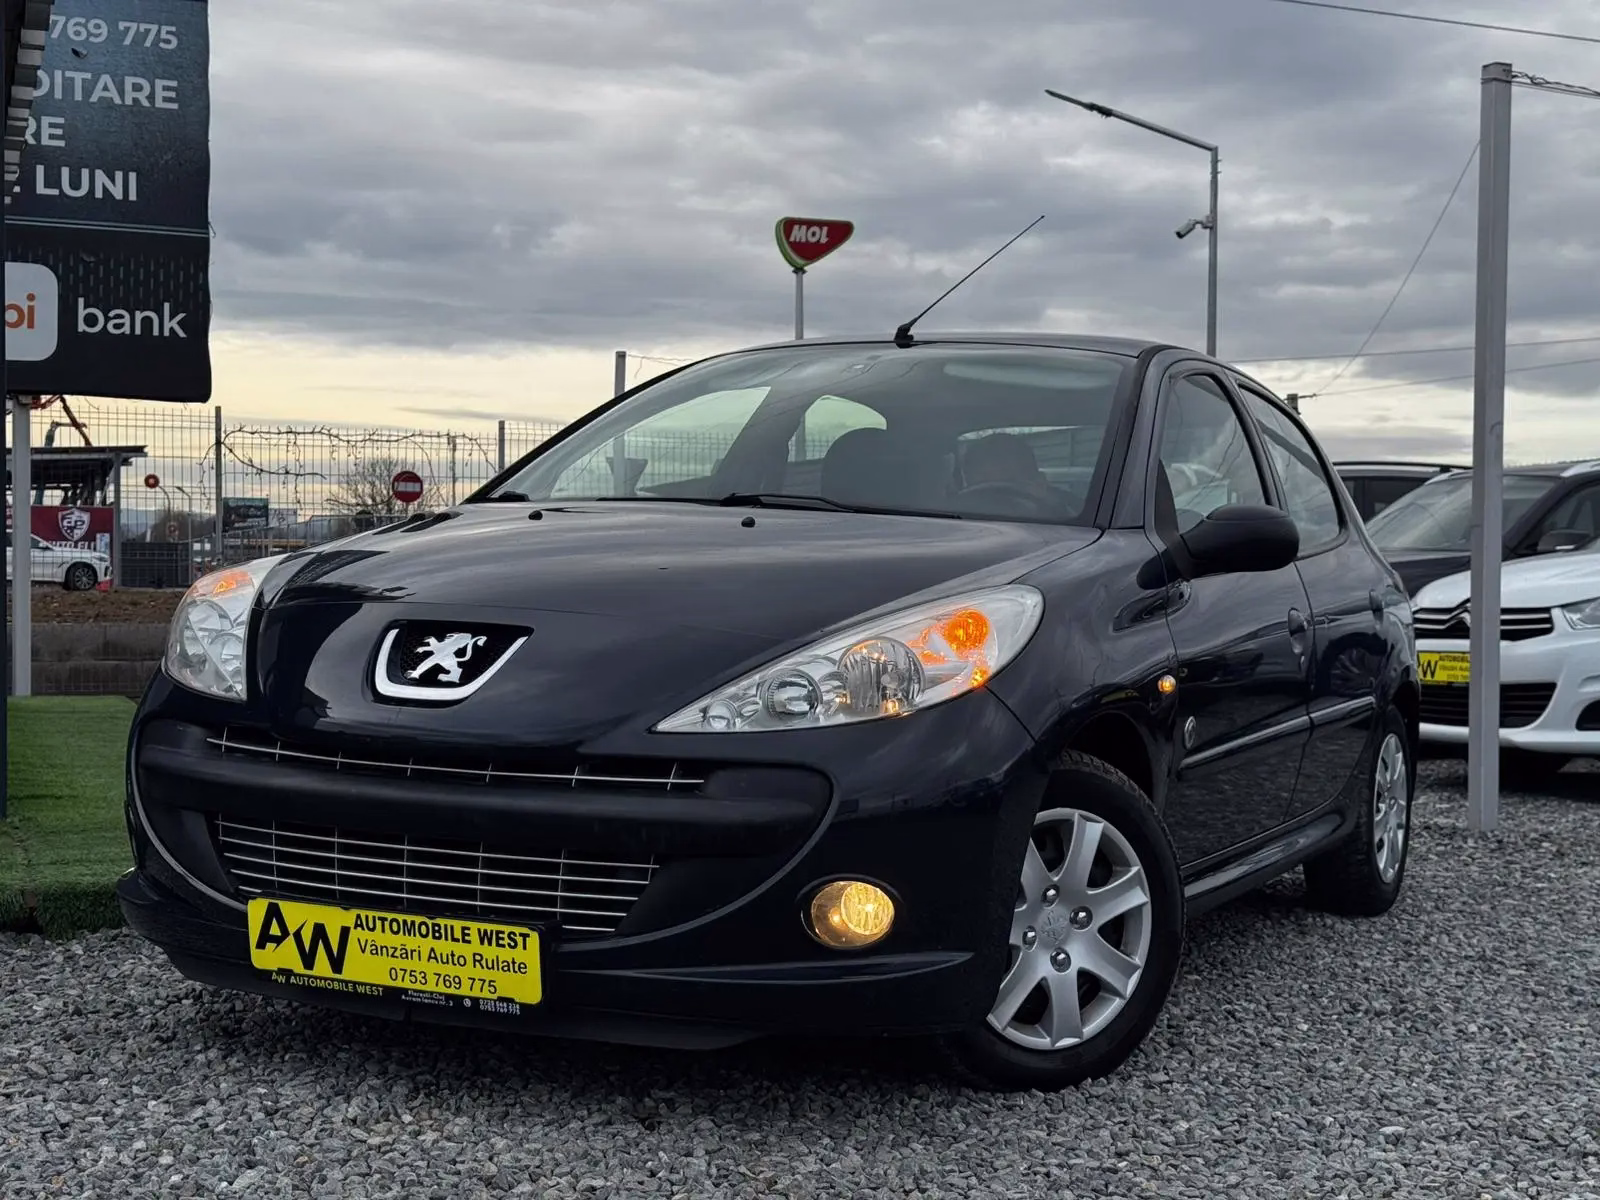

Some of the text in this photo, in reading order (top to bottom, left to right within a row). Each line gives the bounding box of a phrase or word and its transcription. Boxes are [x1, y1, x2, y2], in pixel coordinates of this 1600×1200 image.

[50, 15, 178, 49] 769 775
[35, 164, 137, 201] LUNI
[789, 224, 829, 244] MOL
[77, 297, 188, 337] bank
[353, 913, 472, 945] AUTOMOBILE
[477, 927, 531, 951] WEST
[427, 947, 467, 968] Auto
[472, 952, 528, 975] Rulate
[289, 975, 354, 993] AUTOMOBILE
[356, 984, 384, 996] WEST
[389, 967, 498, 994] 0753 769 775
